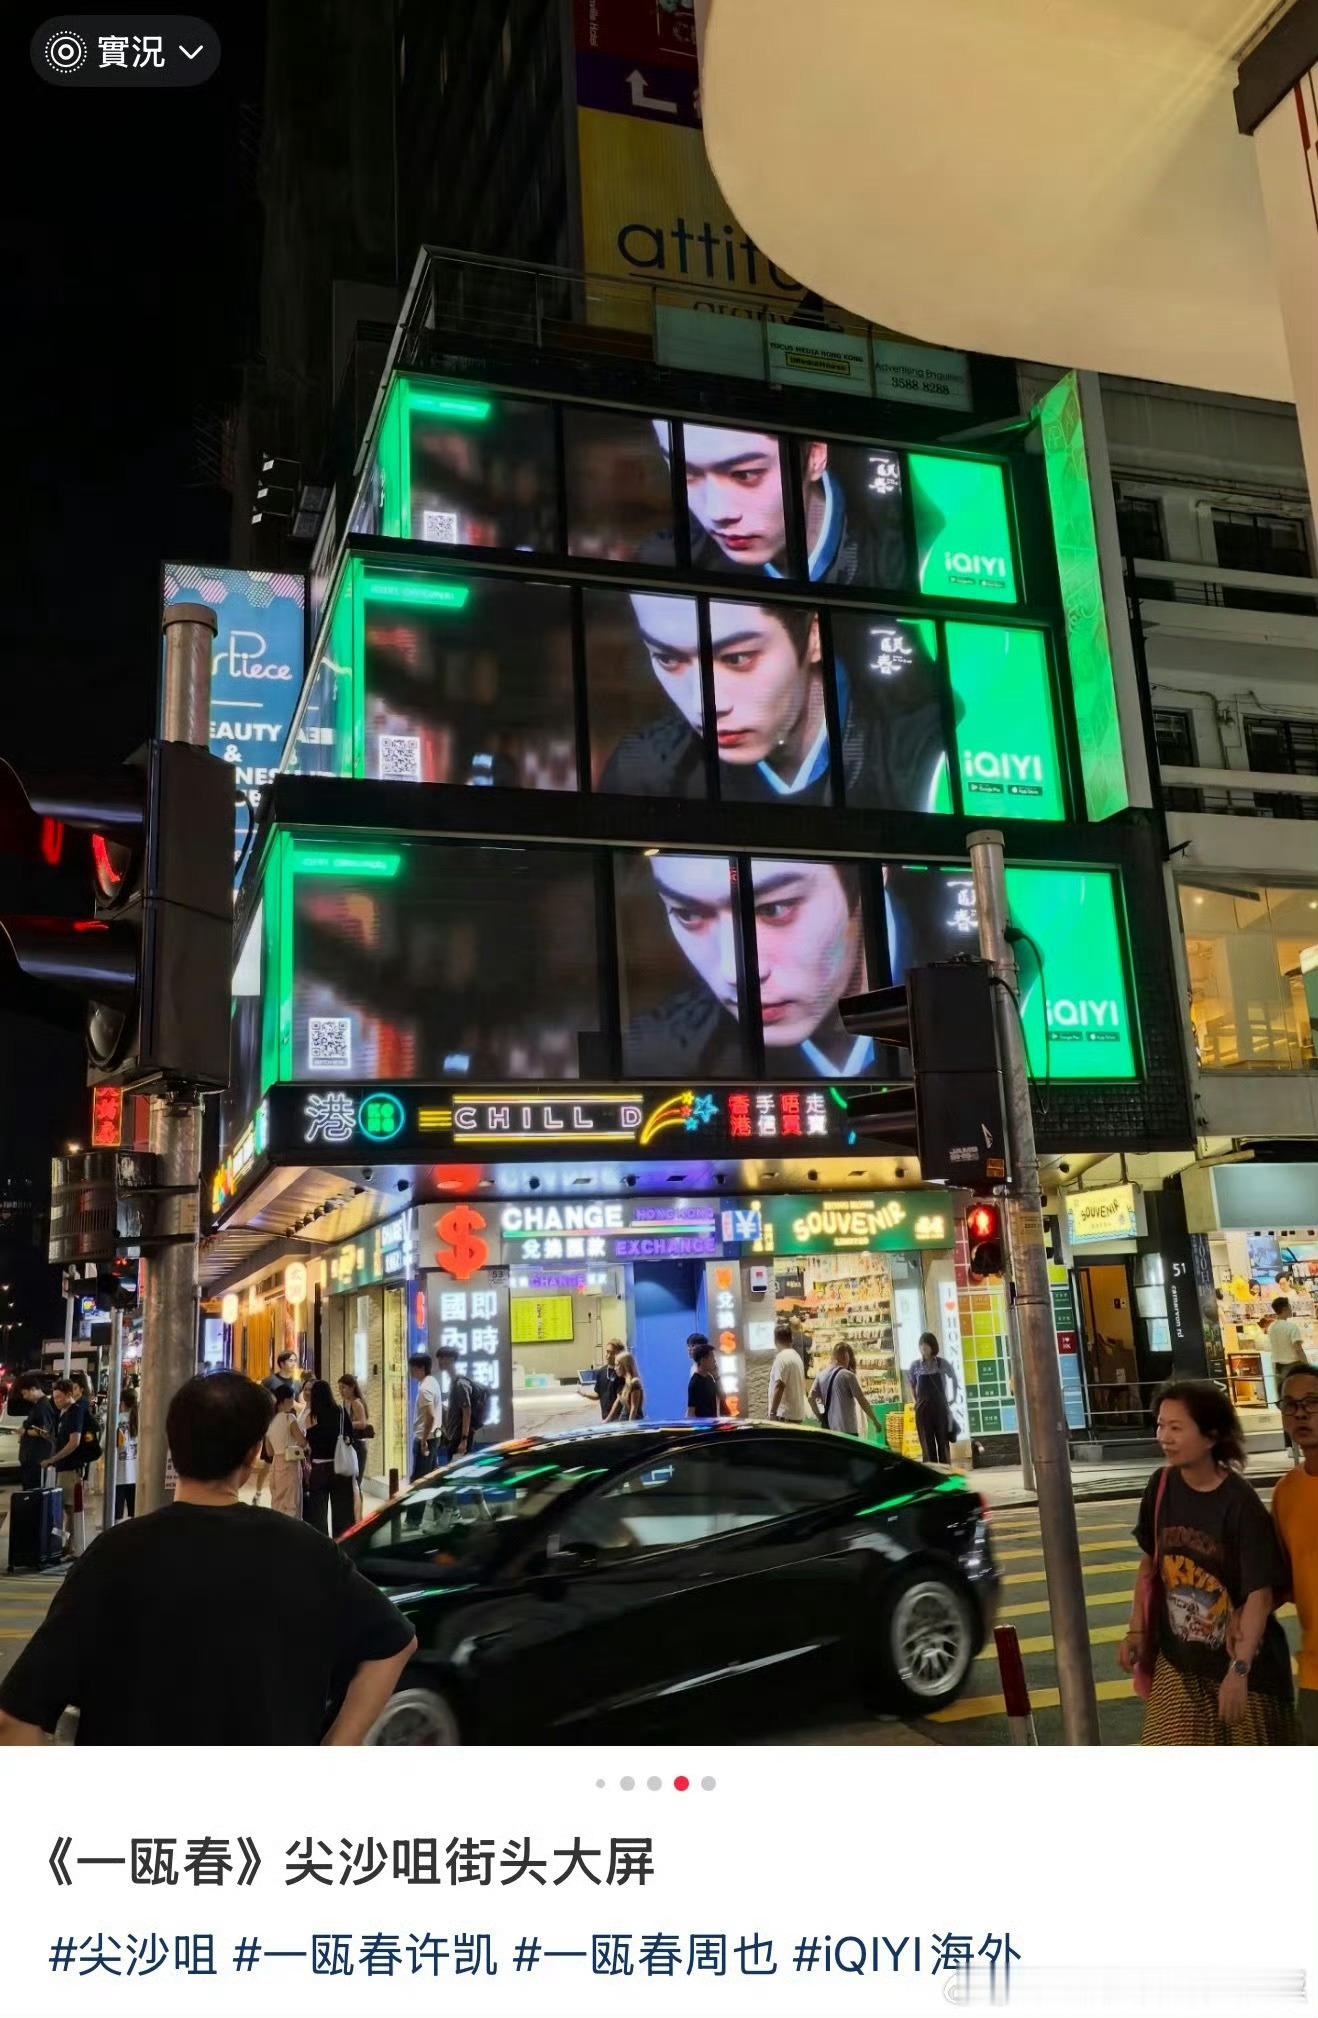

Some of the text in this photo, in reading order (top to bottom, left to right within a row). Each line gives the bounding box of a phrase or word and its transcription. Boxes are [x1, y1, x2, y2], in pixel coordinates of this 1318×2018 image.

[795, 346, 819, 357] MEDIA
[875, 361, 925, 379] Advertising
[944, 551, 1007, 577] iQIYI
[222, 744, 242, 763] &
[963, 750, 1043, 781] iQIYI
[304, 1091, 356, 1142] 港
[454, 1105, 643, 1130] CHILL D
[502, 1204, 625, 1232] CHANGE
[792, 1200, 907, 1242] SOUVENIR
[1080, 1199, 1121, 1222] SOUVENIR
[615, 1238, 717, 1257] EXCHANGE
[1171, 1262, 1188, 1278] 51
